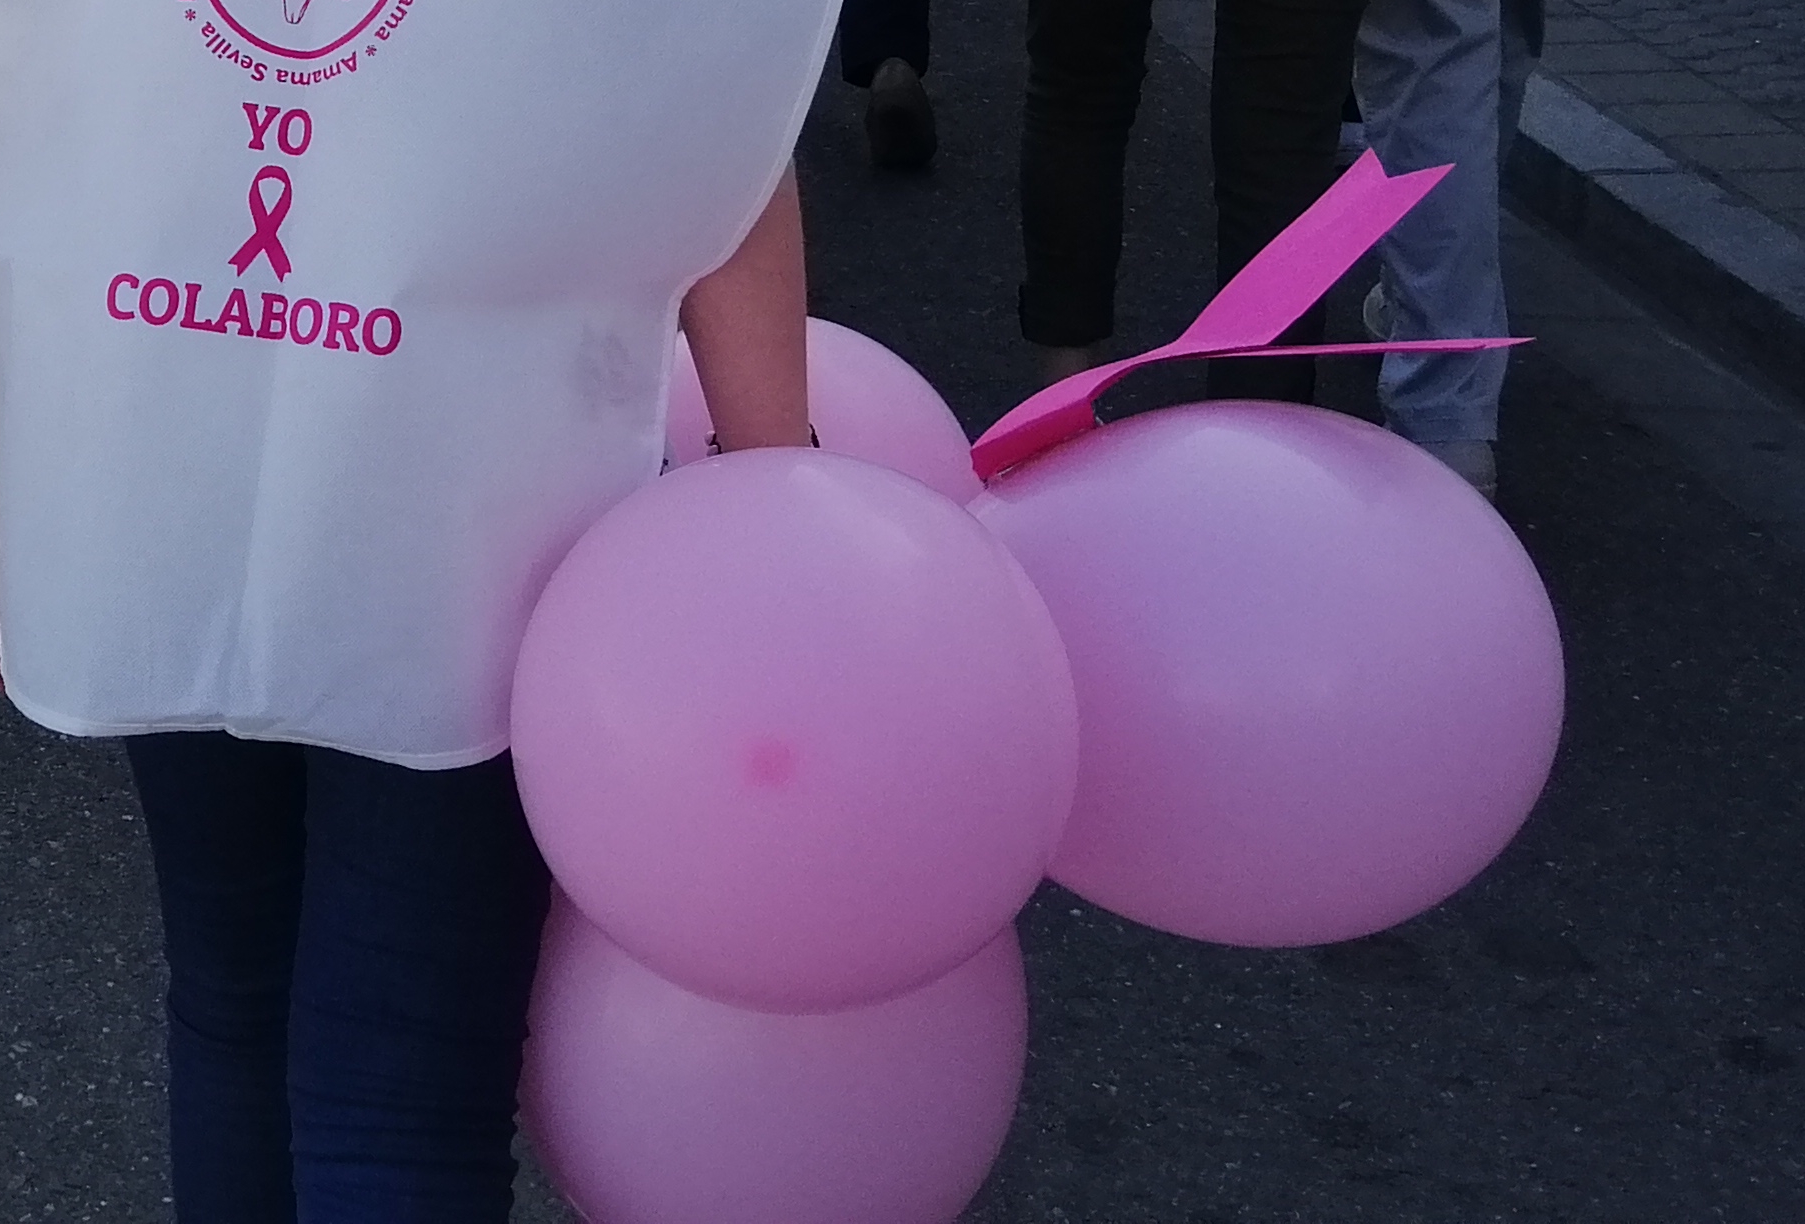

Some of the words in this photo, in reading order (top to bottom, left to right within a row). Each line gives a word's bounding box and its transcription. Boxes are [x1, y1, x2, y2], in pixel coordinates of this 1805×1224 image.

[200, 21, 268, 82] Sevilla
[276, 51, 358, 87] Amama
[242, 102, 313, 156] YO
[106, 273, 402, 356] COLABORO
